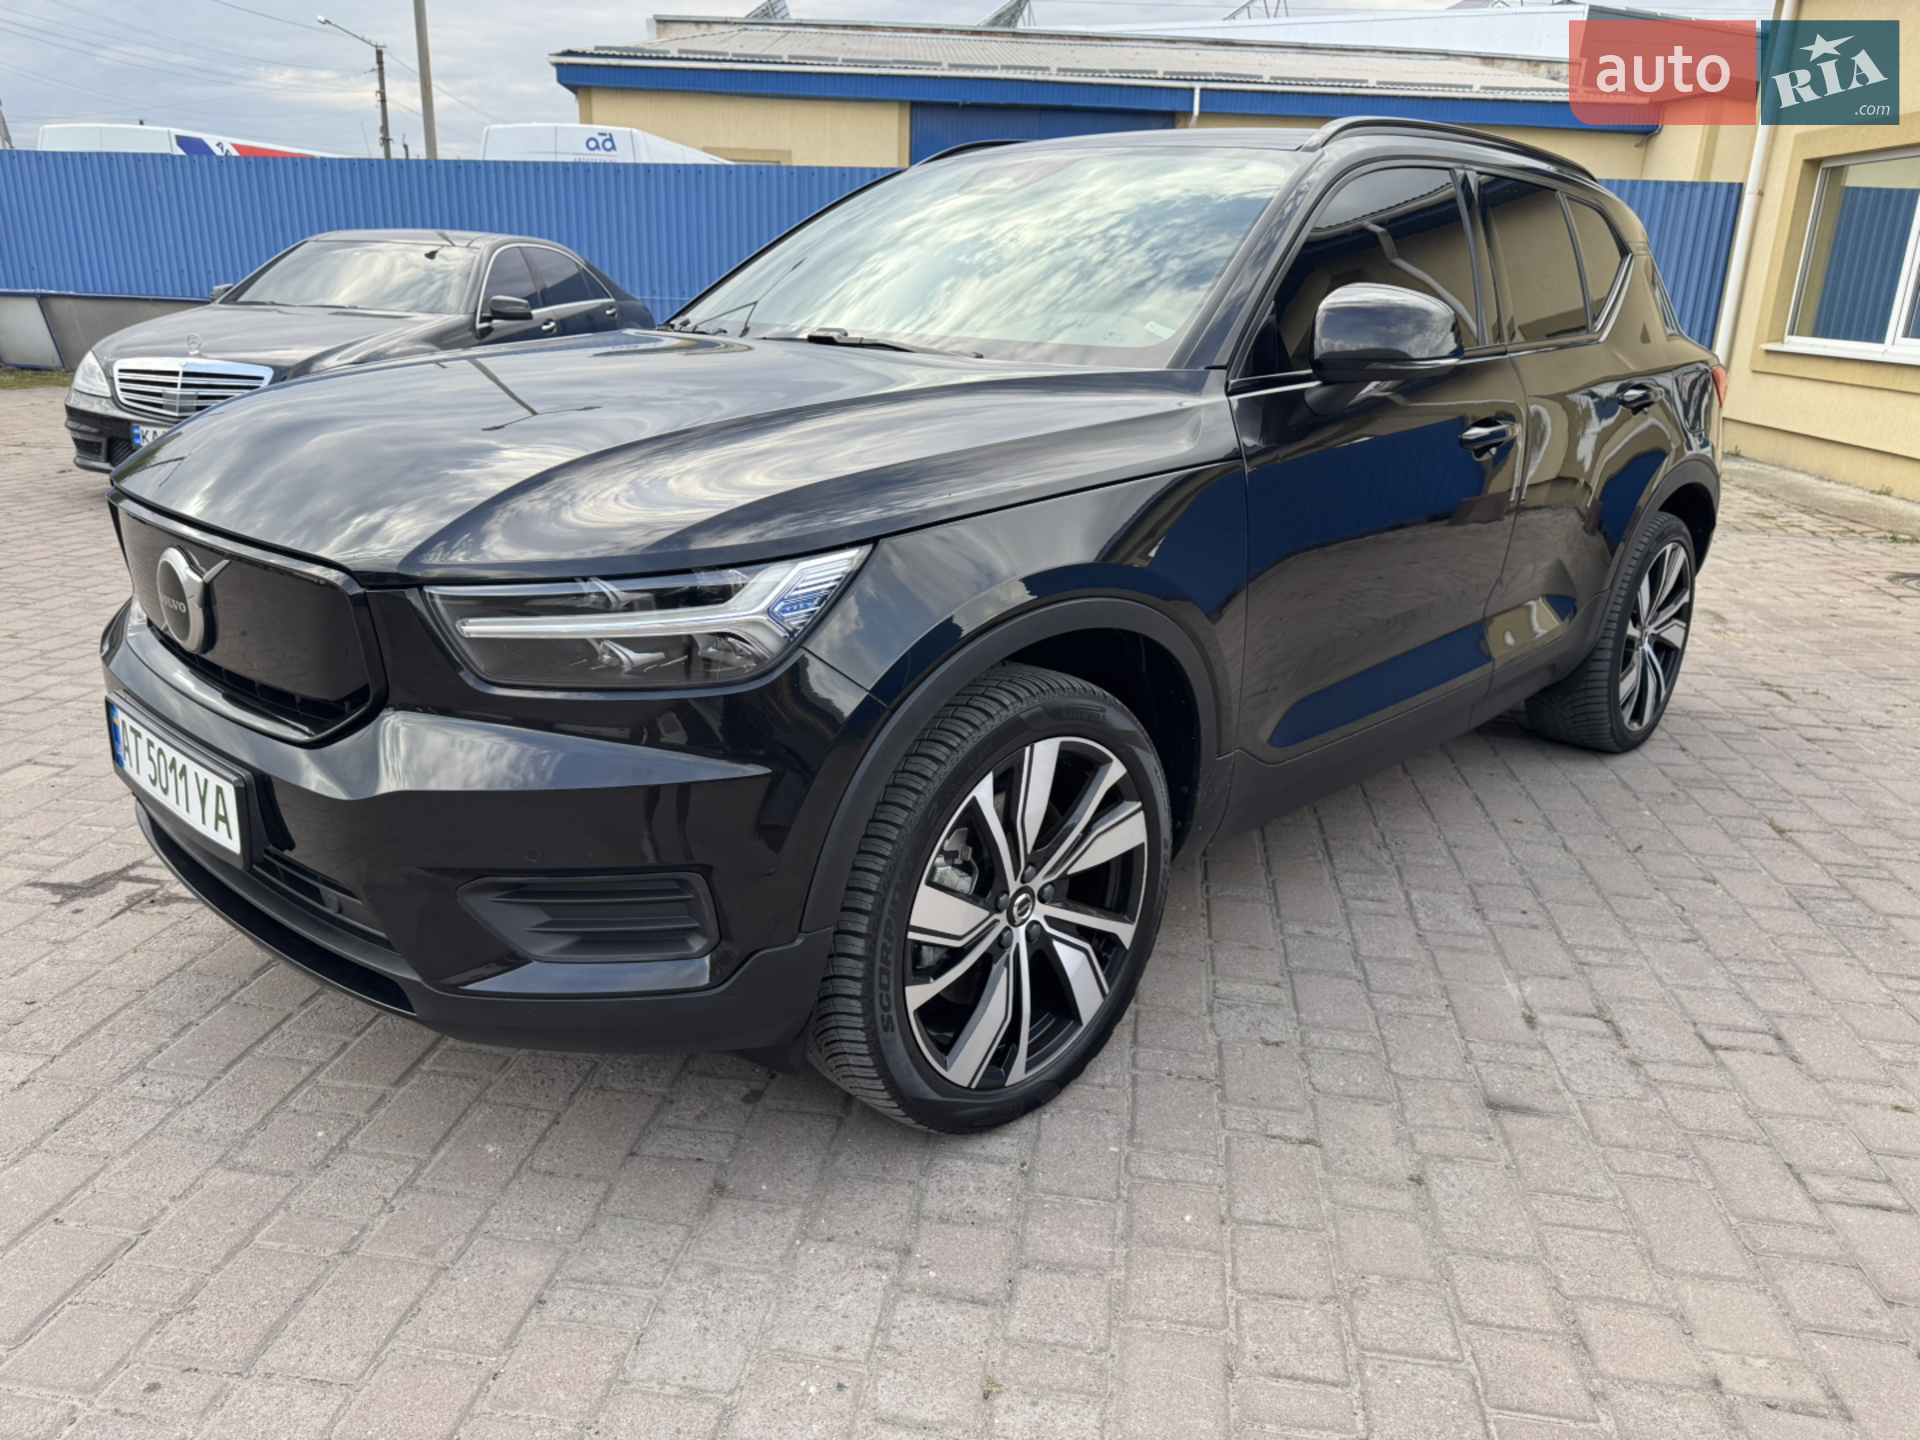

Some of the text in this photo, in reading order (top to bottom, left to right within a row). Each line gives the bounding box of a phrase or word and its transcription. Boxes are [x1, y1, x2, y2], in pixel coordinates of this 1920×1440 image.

[121, 719, 232, 840] AT 5011 YA
